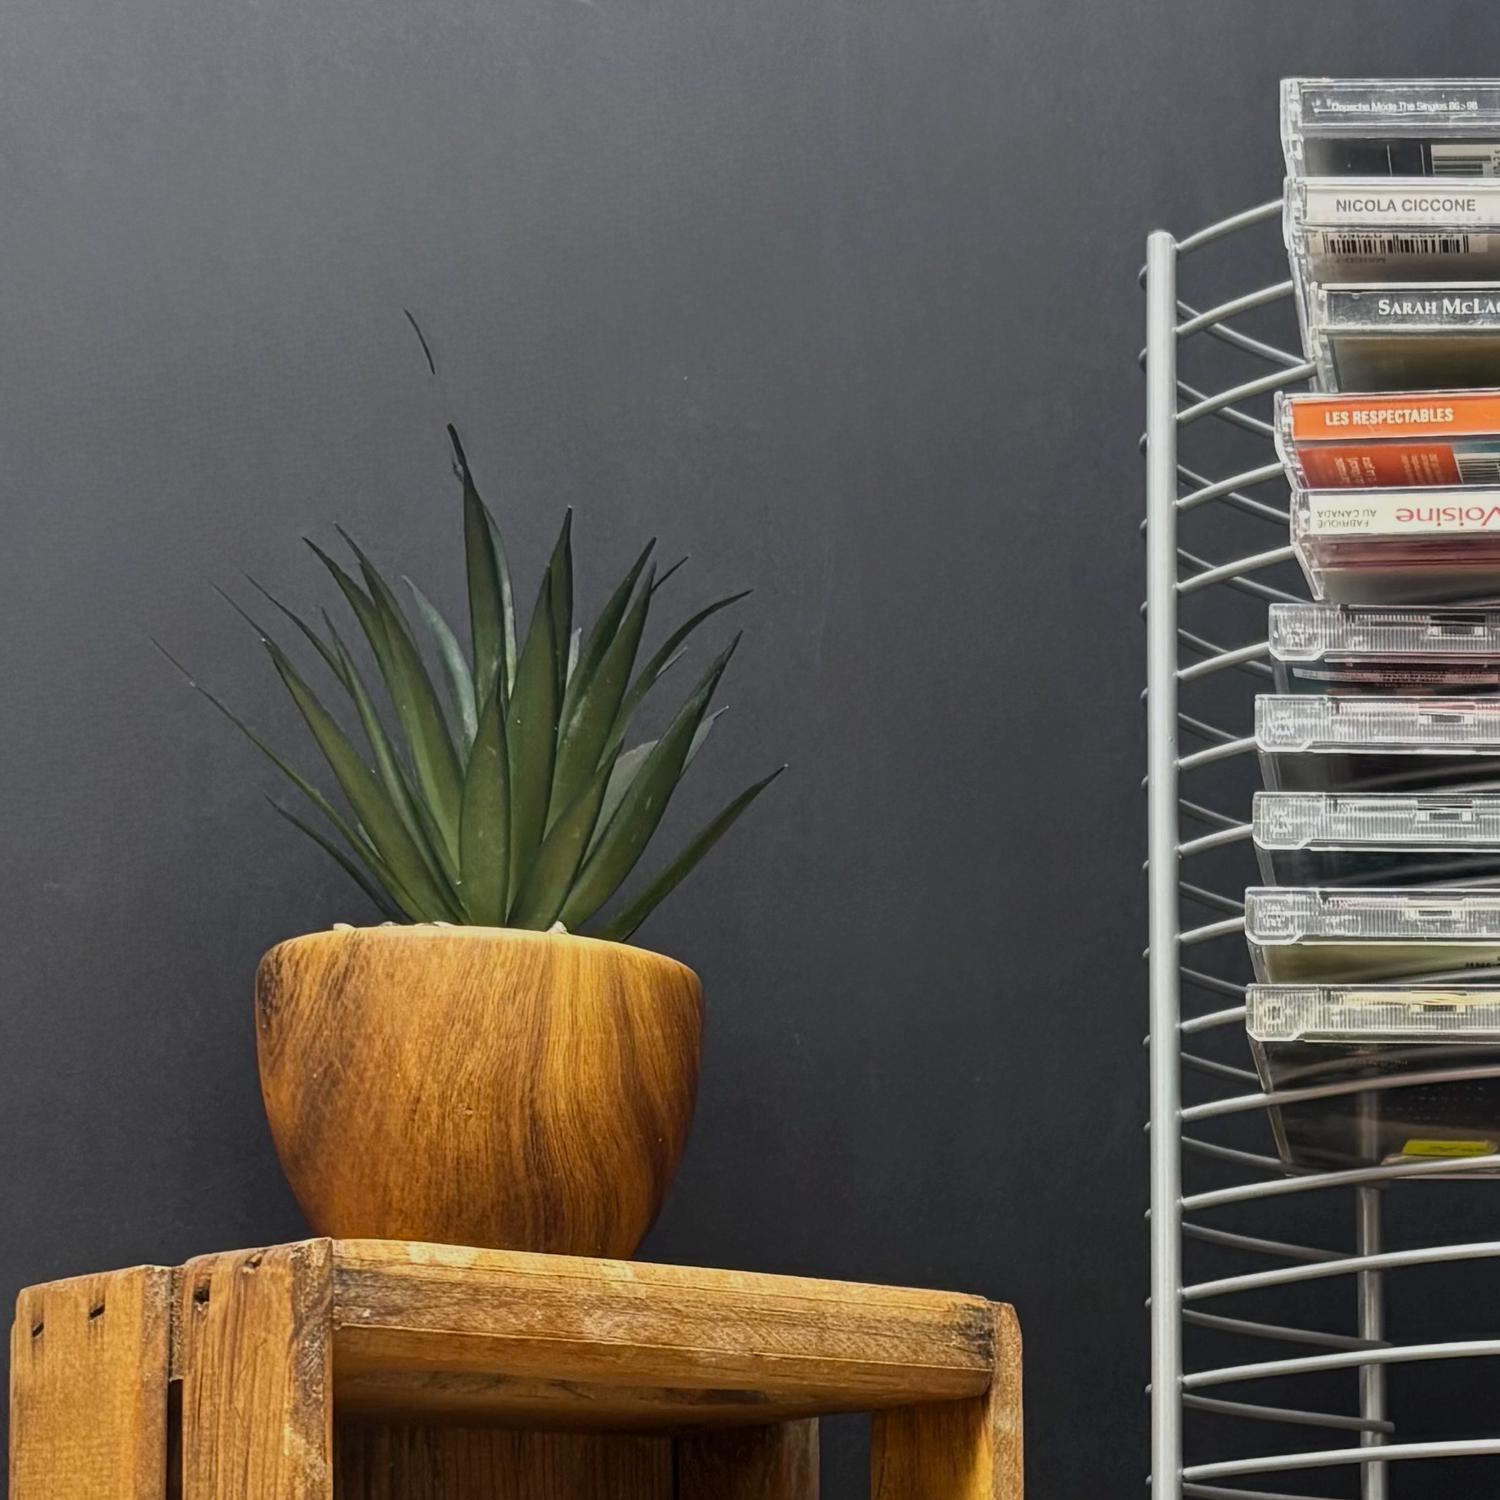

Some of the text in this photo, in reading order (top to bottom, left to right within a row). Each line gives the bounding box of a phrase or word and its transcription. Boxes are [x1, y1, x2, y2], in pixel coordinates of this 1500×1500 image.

[1336, 199, 1476, 212] NICOLA CICCONE
[1325, 407, 1454, 426] LES RESPECTABLES
